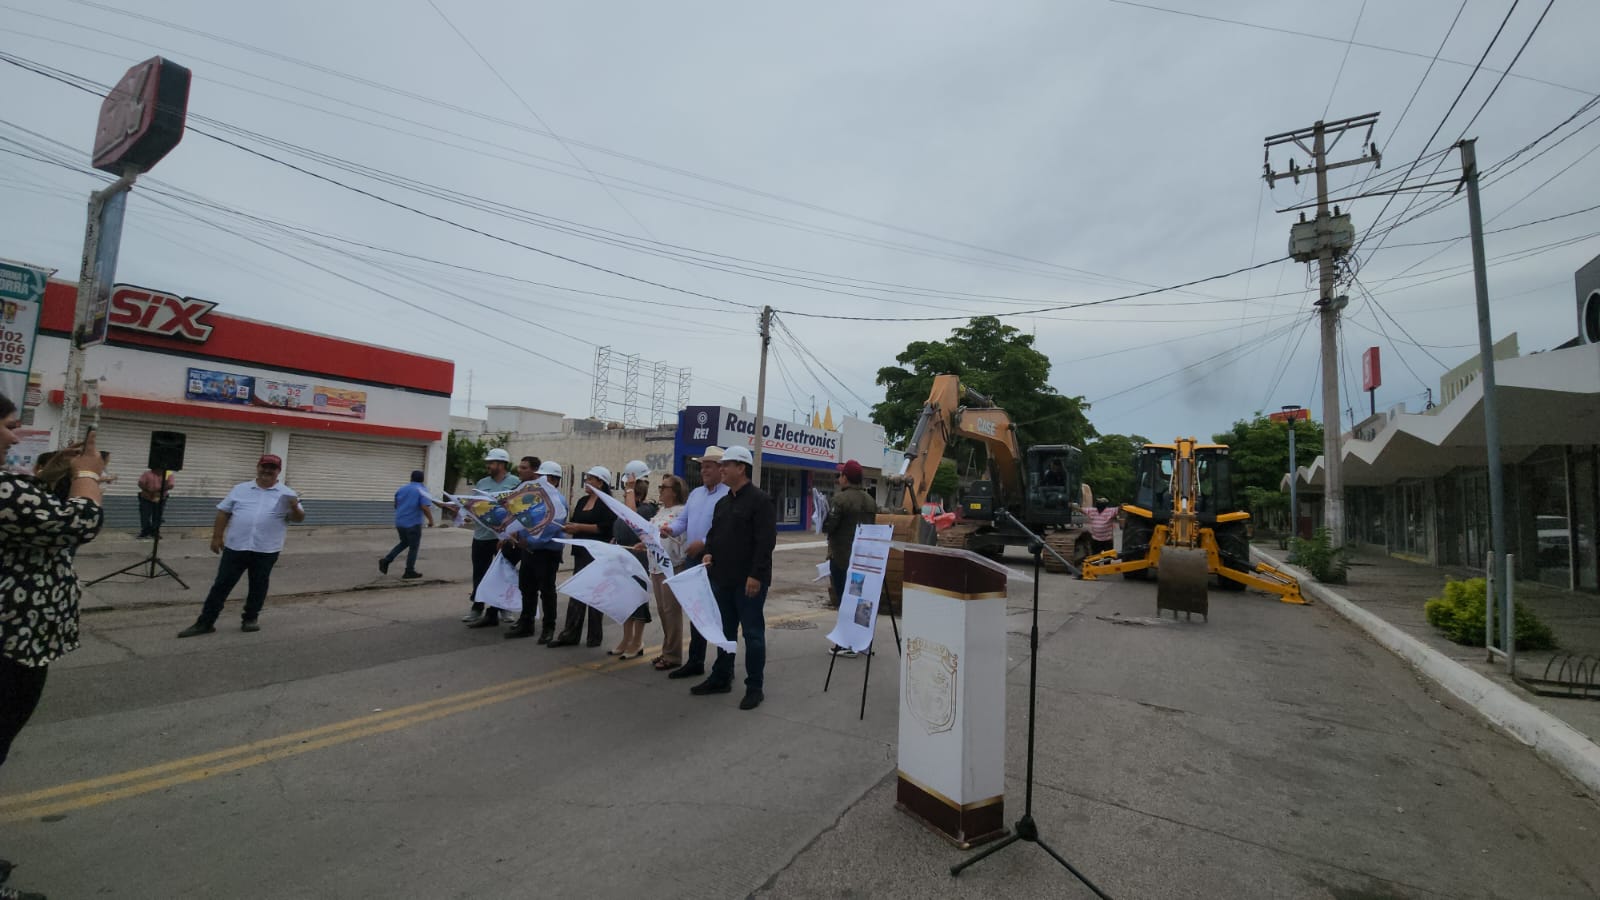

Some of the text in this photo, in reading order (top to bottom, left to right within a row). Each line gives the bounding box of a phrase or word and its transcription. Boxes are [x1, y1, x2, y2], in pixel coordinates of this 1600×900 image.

[725, 412, 836, 450] Rado Electronics
[977, 416, 997, 436] CASE
[747, 436, 830, 457] TCNOLOGIA
